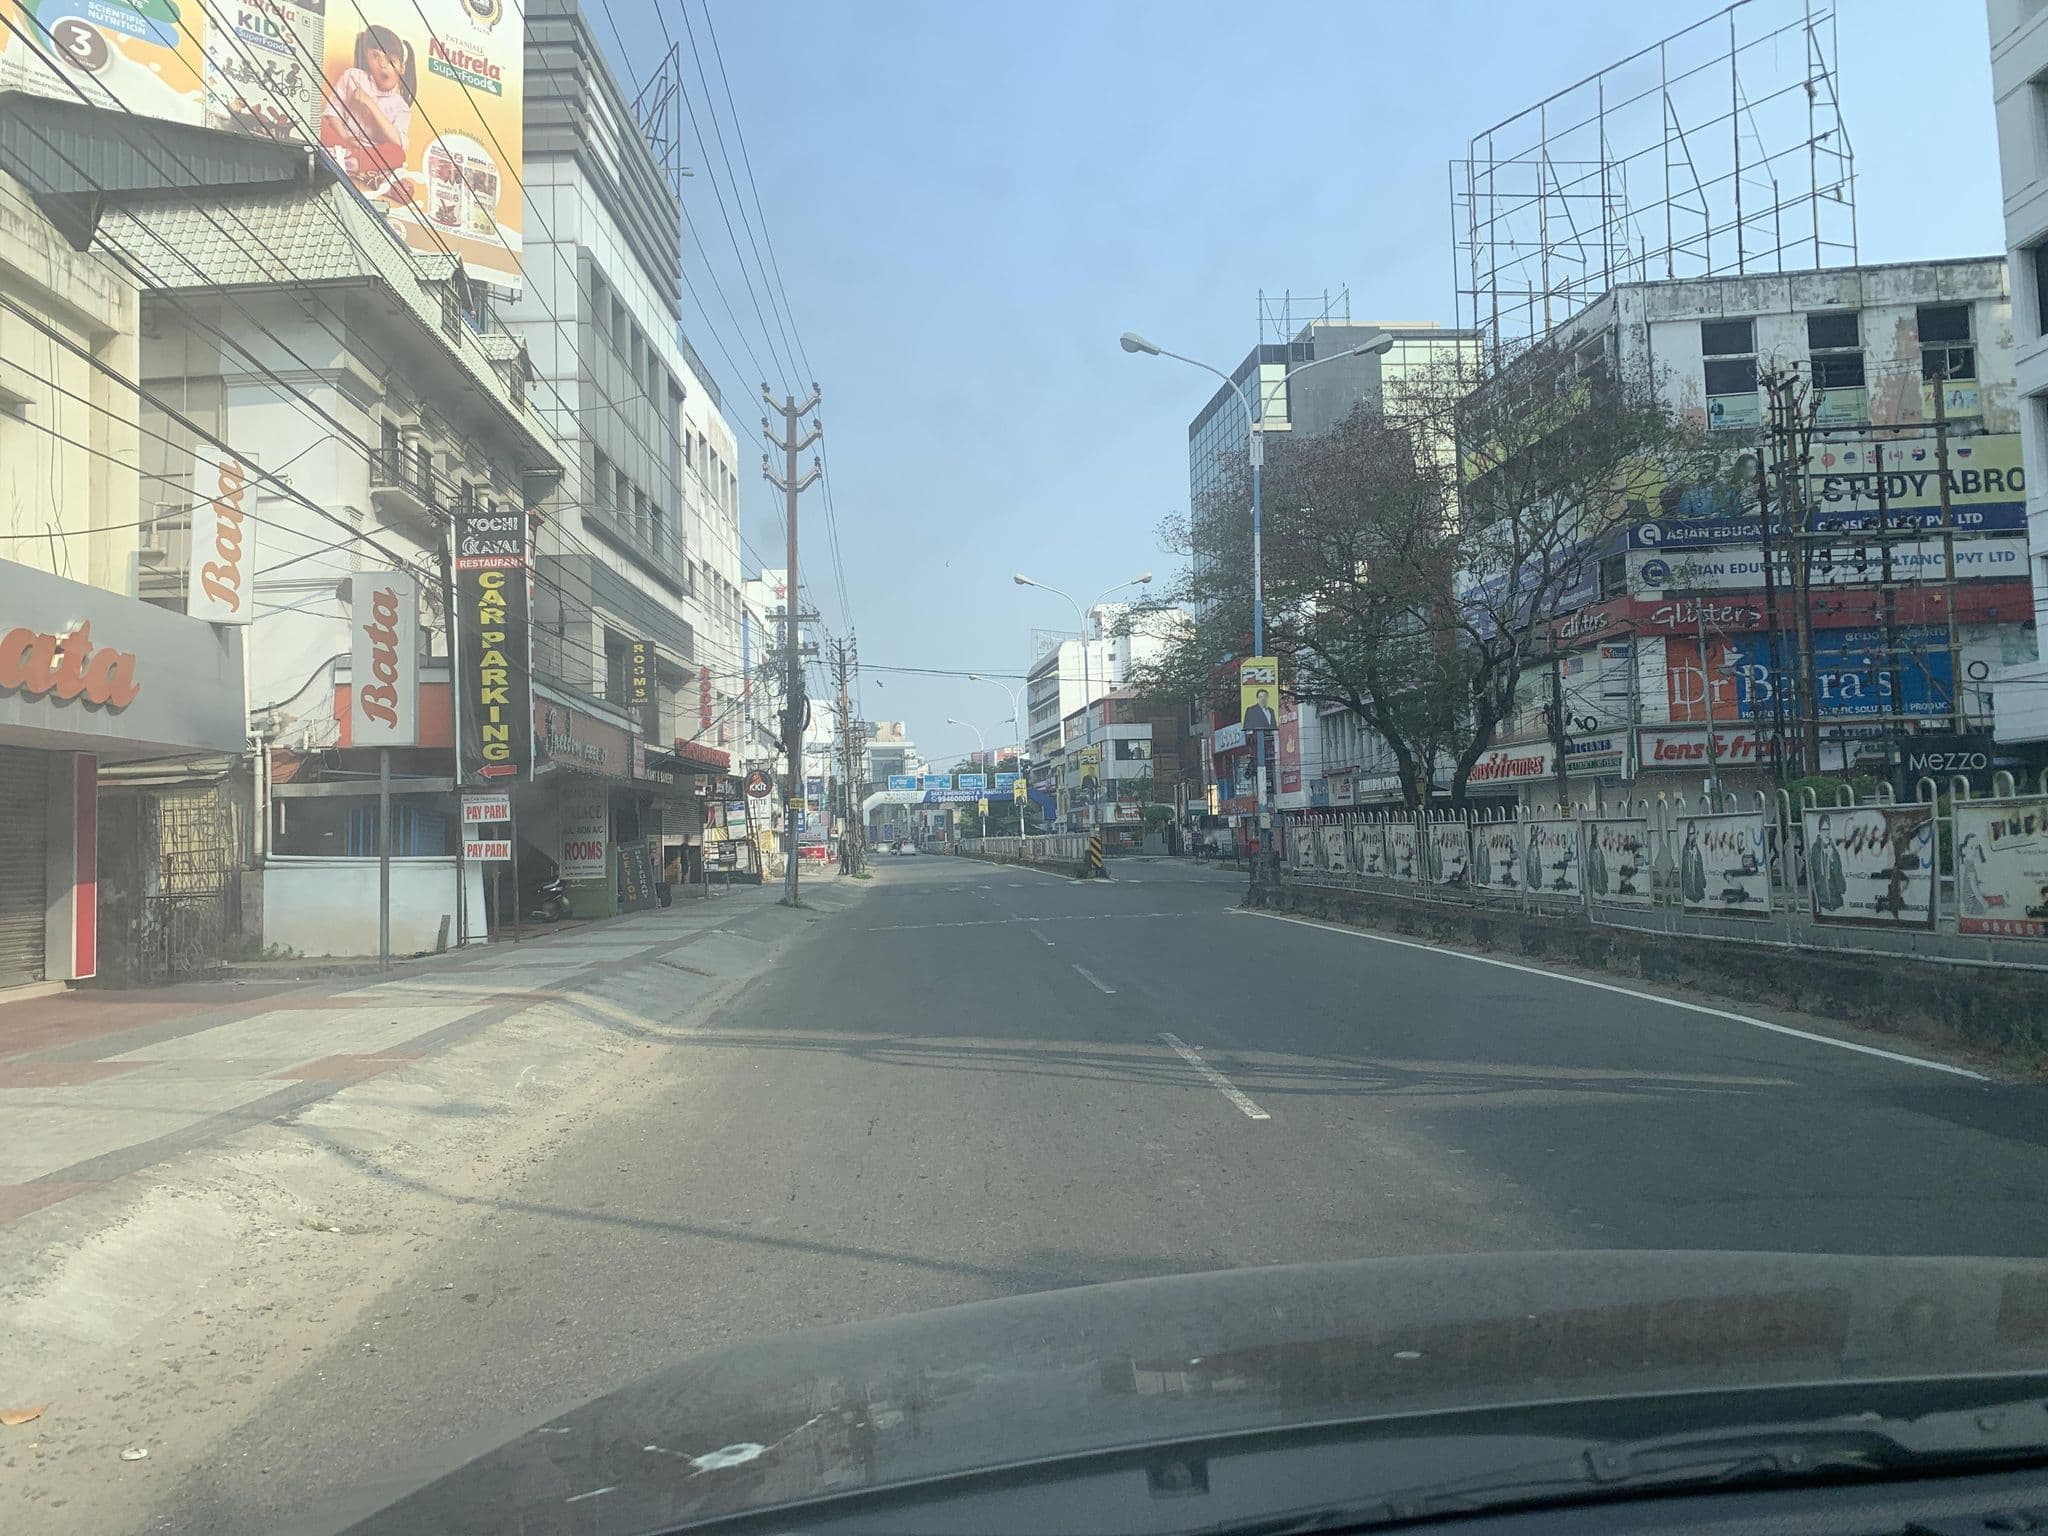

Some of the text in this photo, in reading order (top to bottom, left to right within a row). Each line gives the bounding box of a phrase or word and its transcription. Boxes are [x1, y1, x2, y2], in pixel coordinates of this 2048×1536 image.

[87, 1, 147, 28] SCIENTIFIC
[87, 9, 147, 36] NUTRITION
[69, 25, 92, 57] 3
[429, 37, 501, 81] Nutrela
[1823, 473, 1929, 503] STUDY
[199, 458, 248, 614] Bata
[467, 517, 518, 532] KOCHI
[1665, 527, 1710, 541] ASIAN
[1957, 512, 1984, 525] LTD
[463, 537, 521, 556] KAYAL
[1956, 551, 1986, 564] PVT
[1989, 550, 2016, 563] LTD
[459, 558, 524, 569] RESTAURANT
[478, 571, 507, 625] CAR
[360, 586, 401, 730] Bata
[633, 644, 647, 698] ROOMS
[479, 631, 511, 761] PARKING
[1668, 663, 1731, 705] Dr
[466, 804, 508, 820] PAY PARK
[467, 843, 509, 858] PAY PARK
[564, 840, 603, 861] ROOMS
